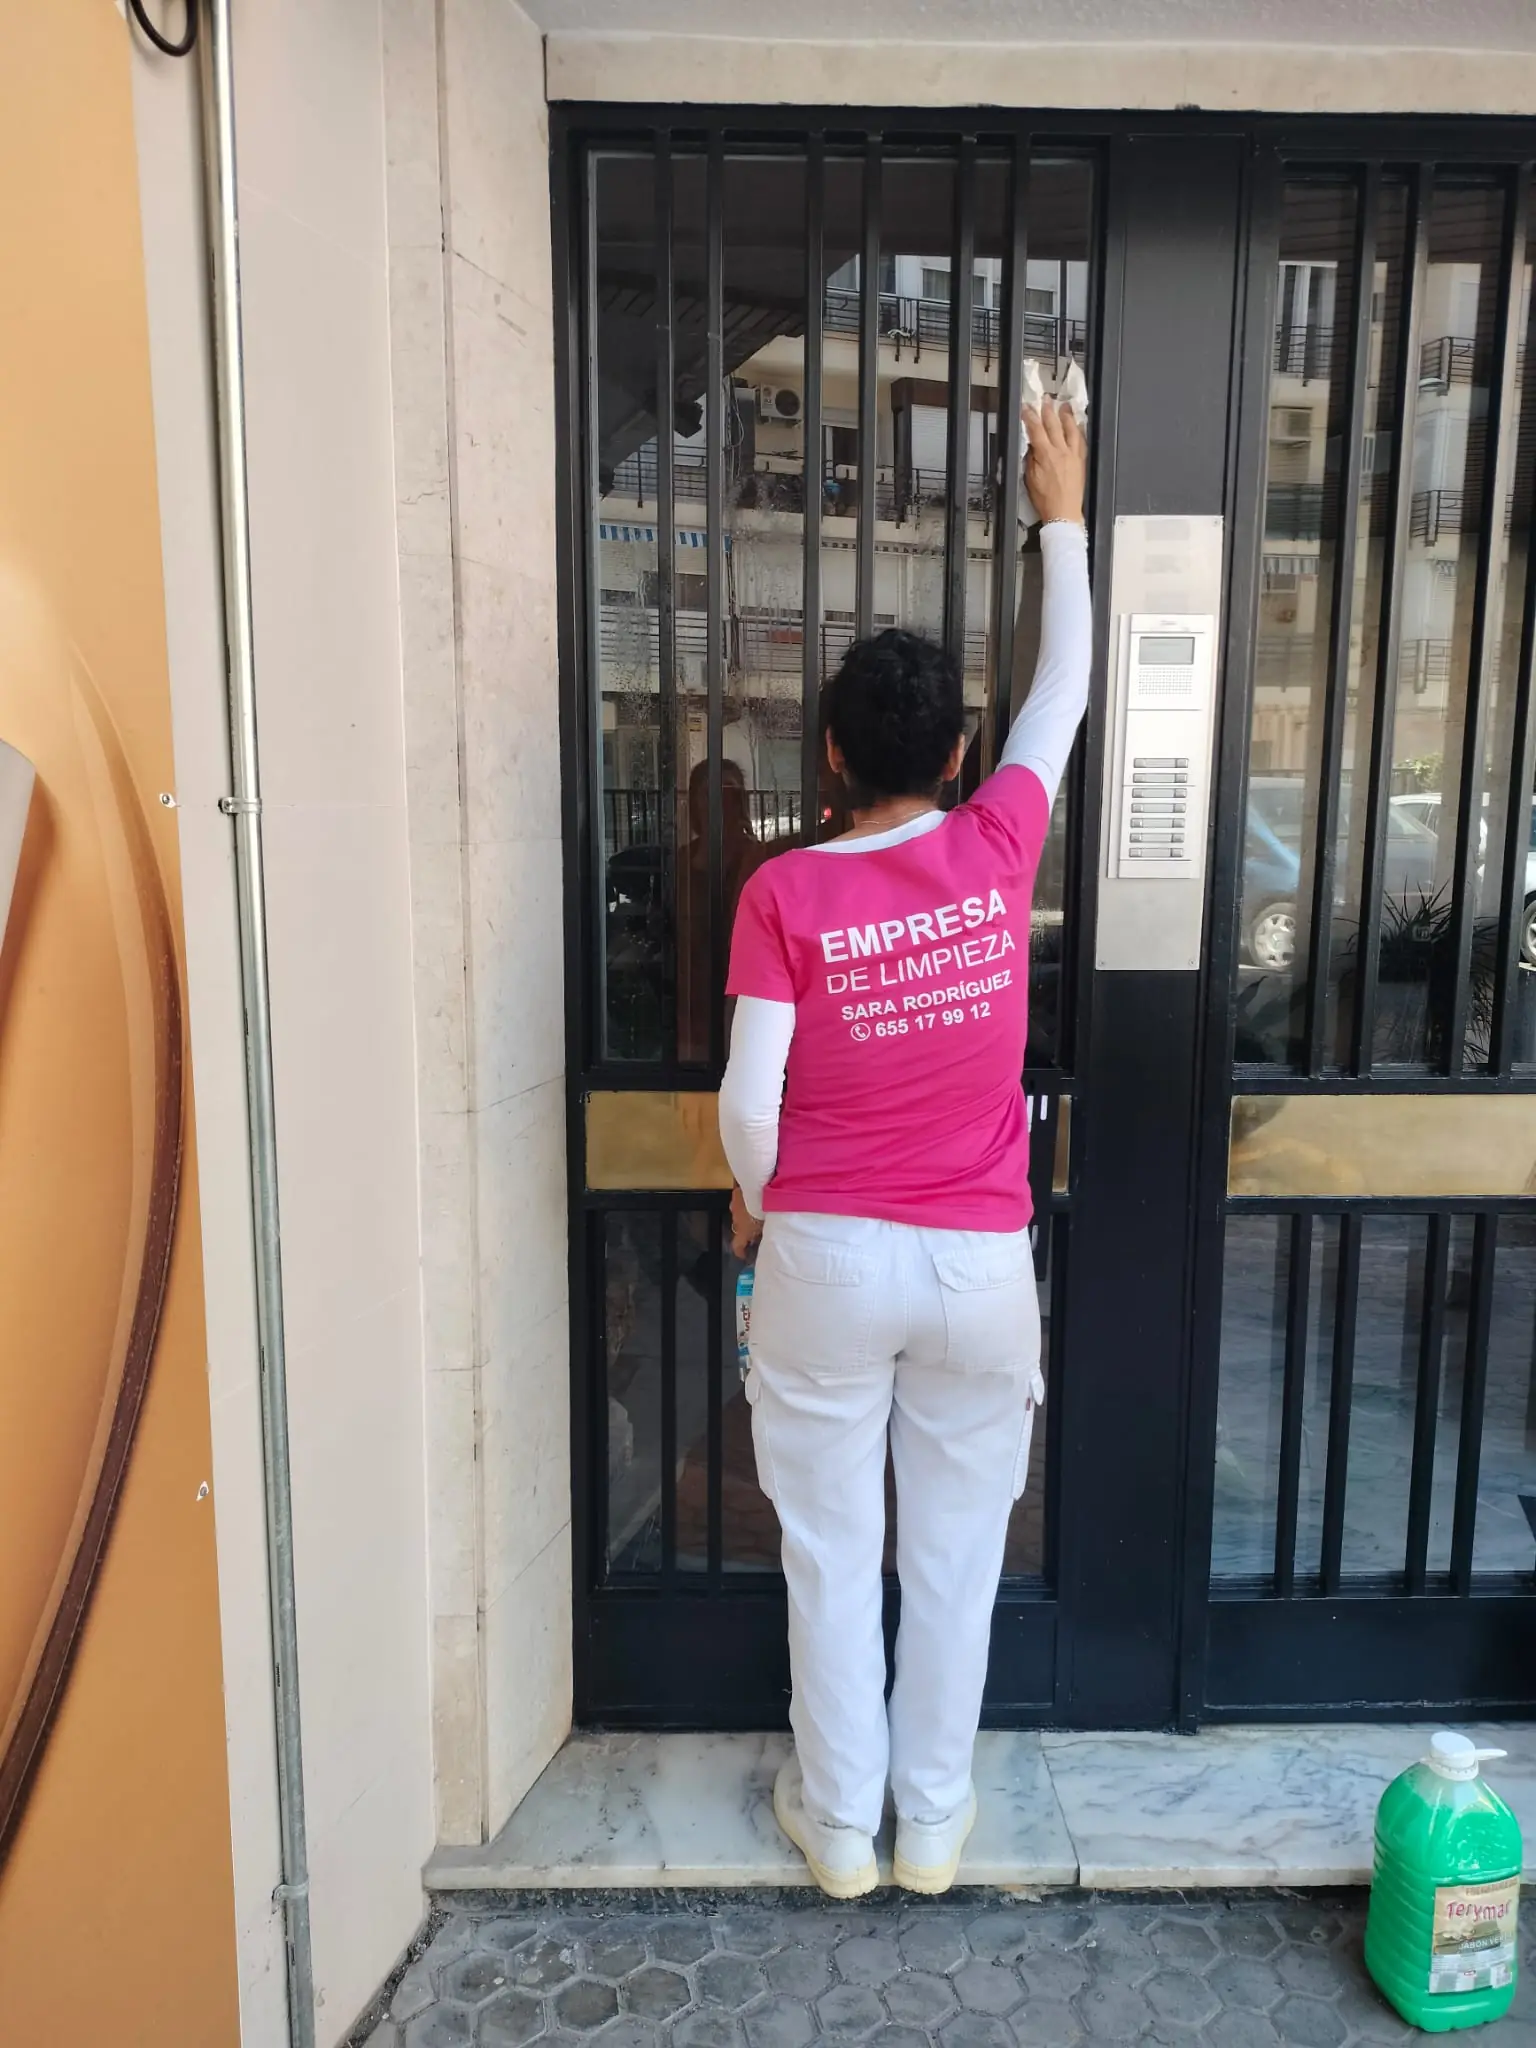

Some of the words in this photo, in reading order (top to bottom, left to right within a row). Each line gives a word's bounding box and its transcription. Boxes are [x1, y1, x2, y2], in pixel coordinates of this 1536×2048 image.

[819, 888, 1007, 964] EMPRESA
[826, 966, 871, 994] DE
[879, 929, 1016, 987] LIMPIEZA
[841, 999, 898, 1021] SARA
[902, 969, 1013, 1012] RODRÍGUEZ
[875, 1018, 909, 1037] 655
[914, 1013, 936, 1031] 17
[942, 1008, 964, 1026] 99
[970, 1001, 991, 1020] 12
[1447, 1900, 1512, 1922] Terymar
